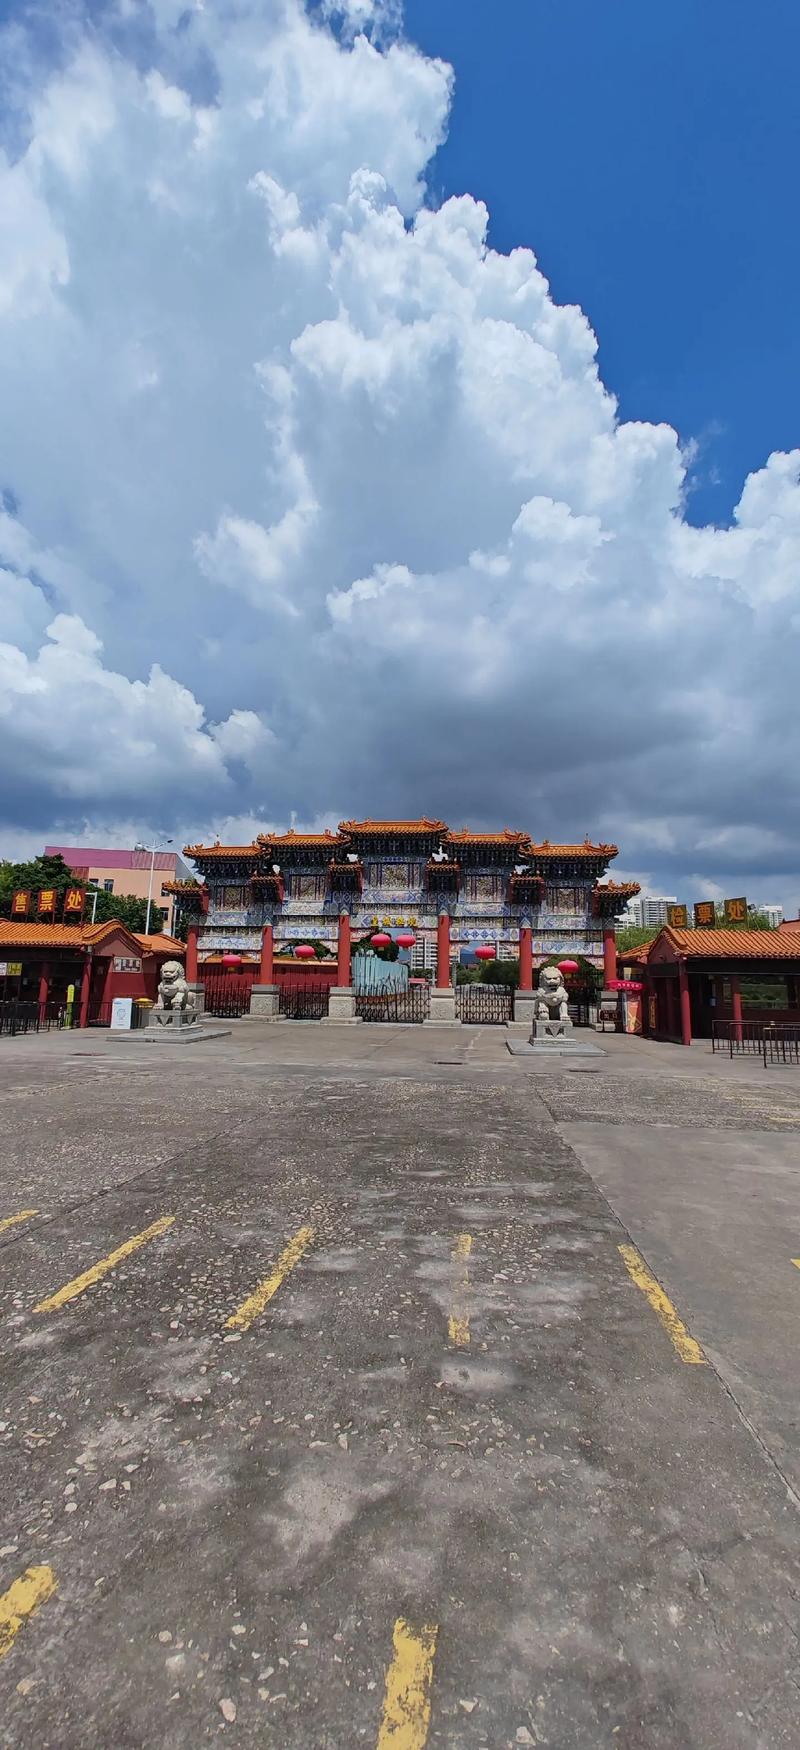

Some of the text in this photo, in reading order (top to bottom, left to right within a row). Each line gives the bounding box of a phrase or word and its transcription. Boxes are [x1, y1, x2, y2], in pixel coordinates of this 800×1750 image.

[15, 890, 82, 912] 售票处
[670, 900, 745, 927] 检票处
